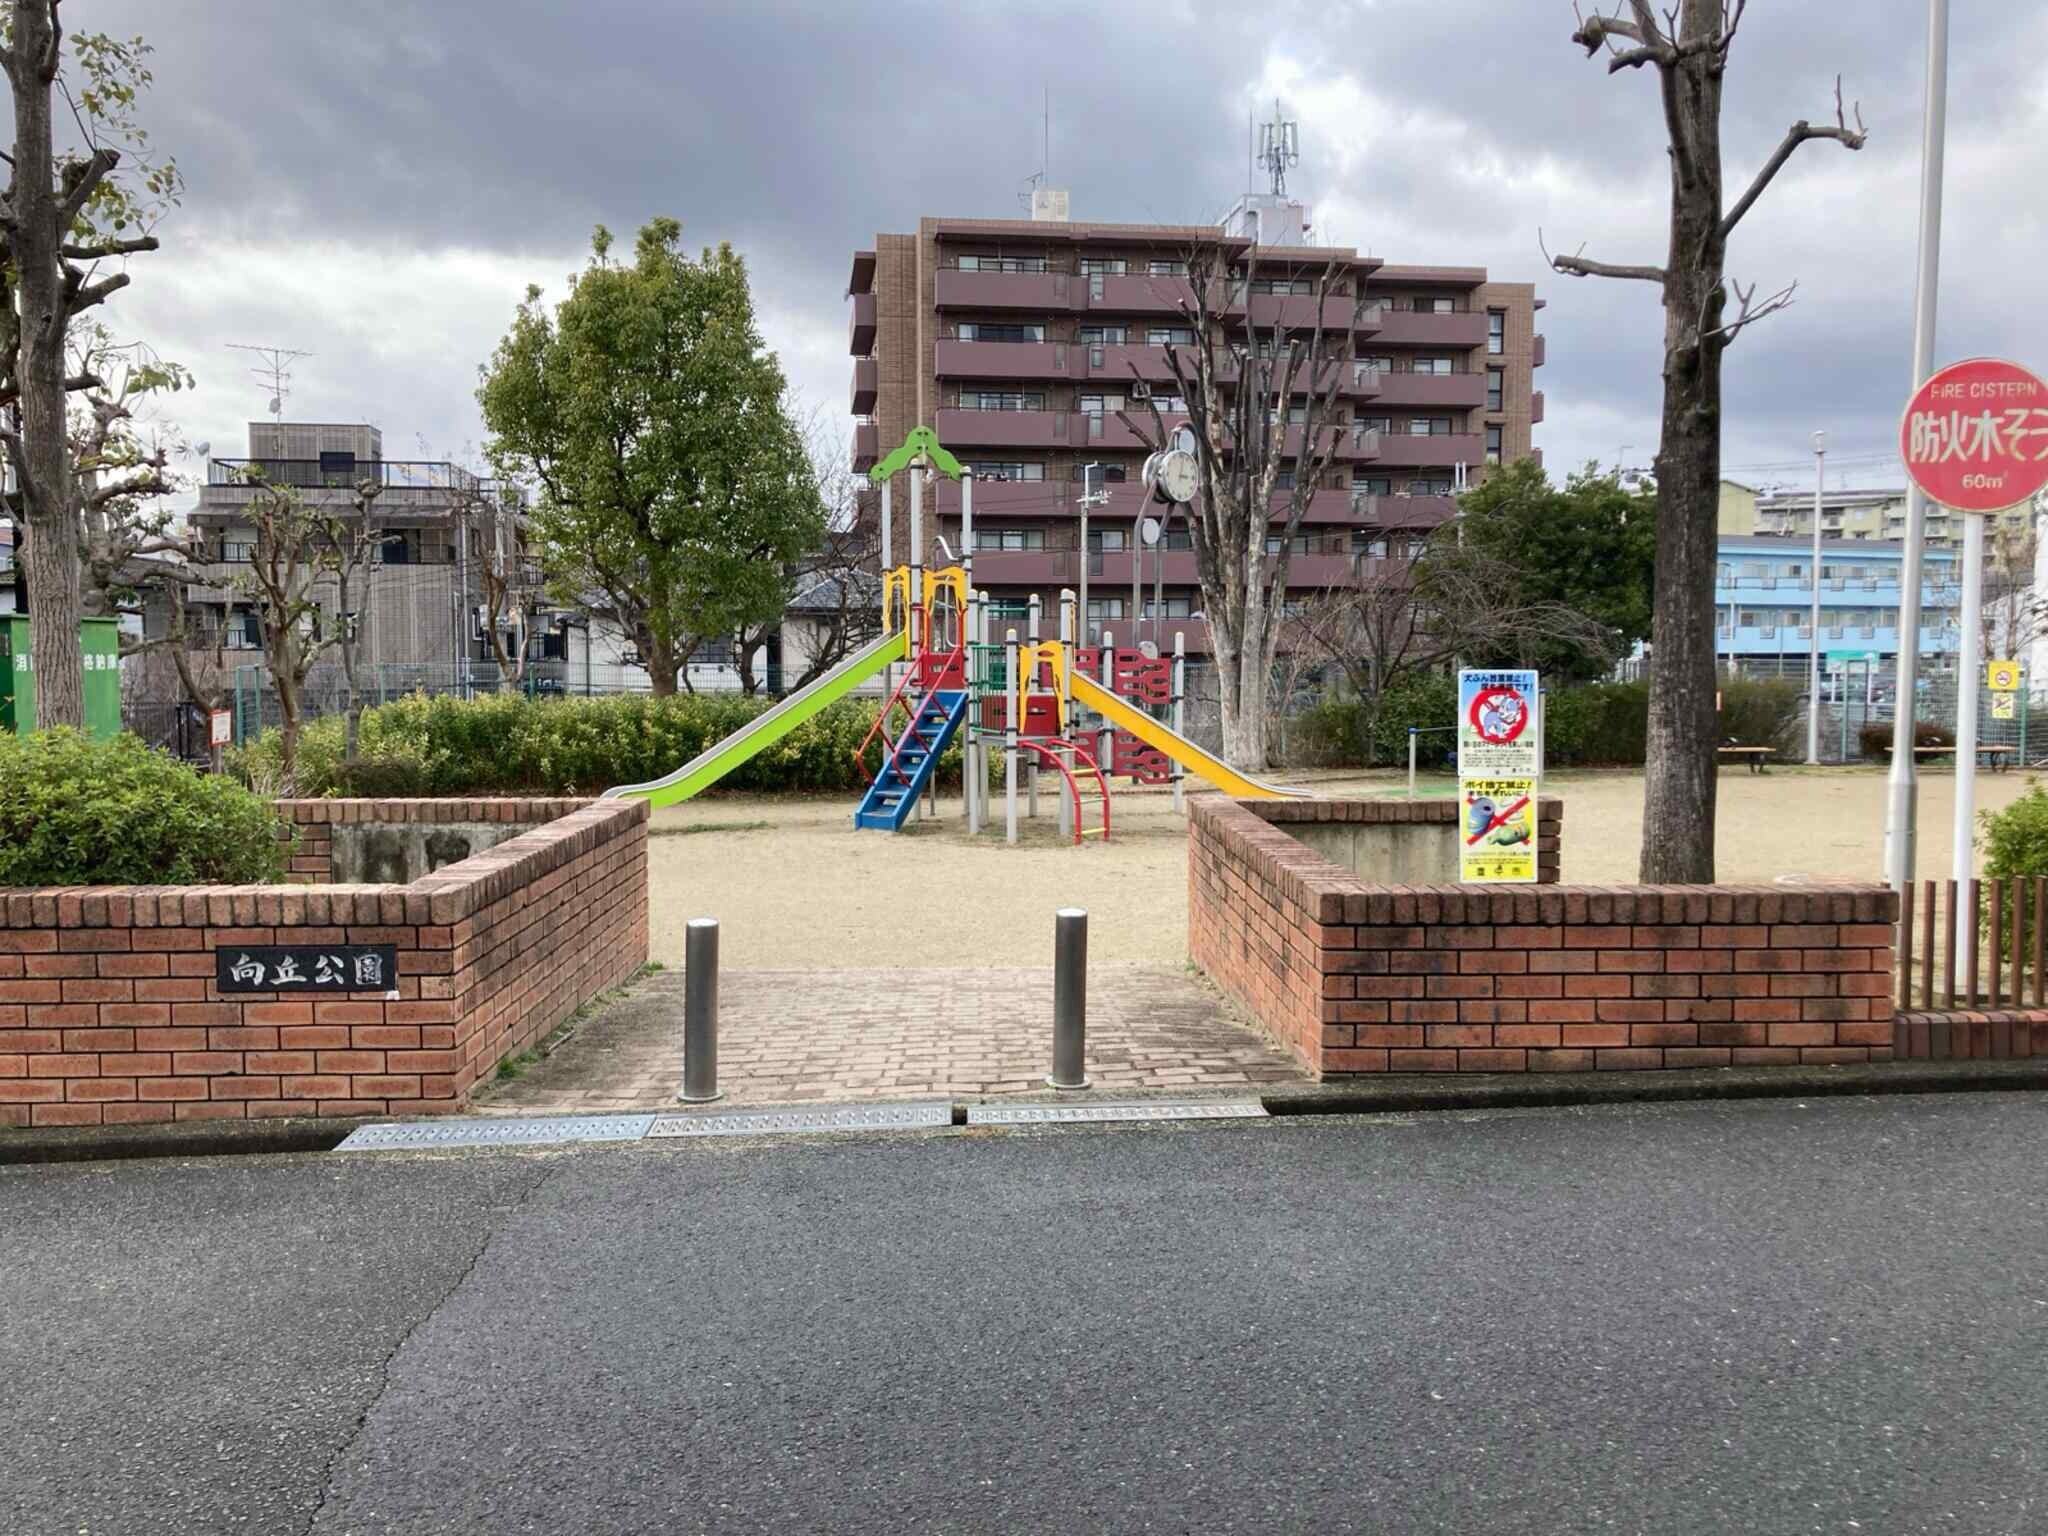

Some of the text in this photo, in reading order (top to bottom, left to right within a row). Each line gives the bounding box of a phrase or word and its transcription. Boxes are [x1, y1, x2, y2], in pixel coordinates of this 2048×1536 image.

[1930, 381, 2038, 399] FIRE CISTERN
[230, 953, 382, 986] 向丘公園
